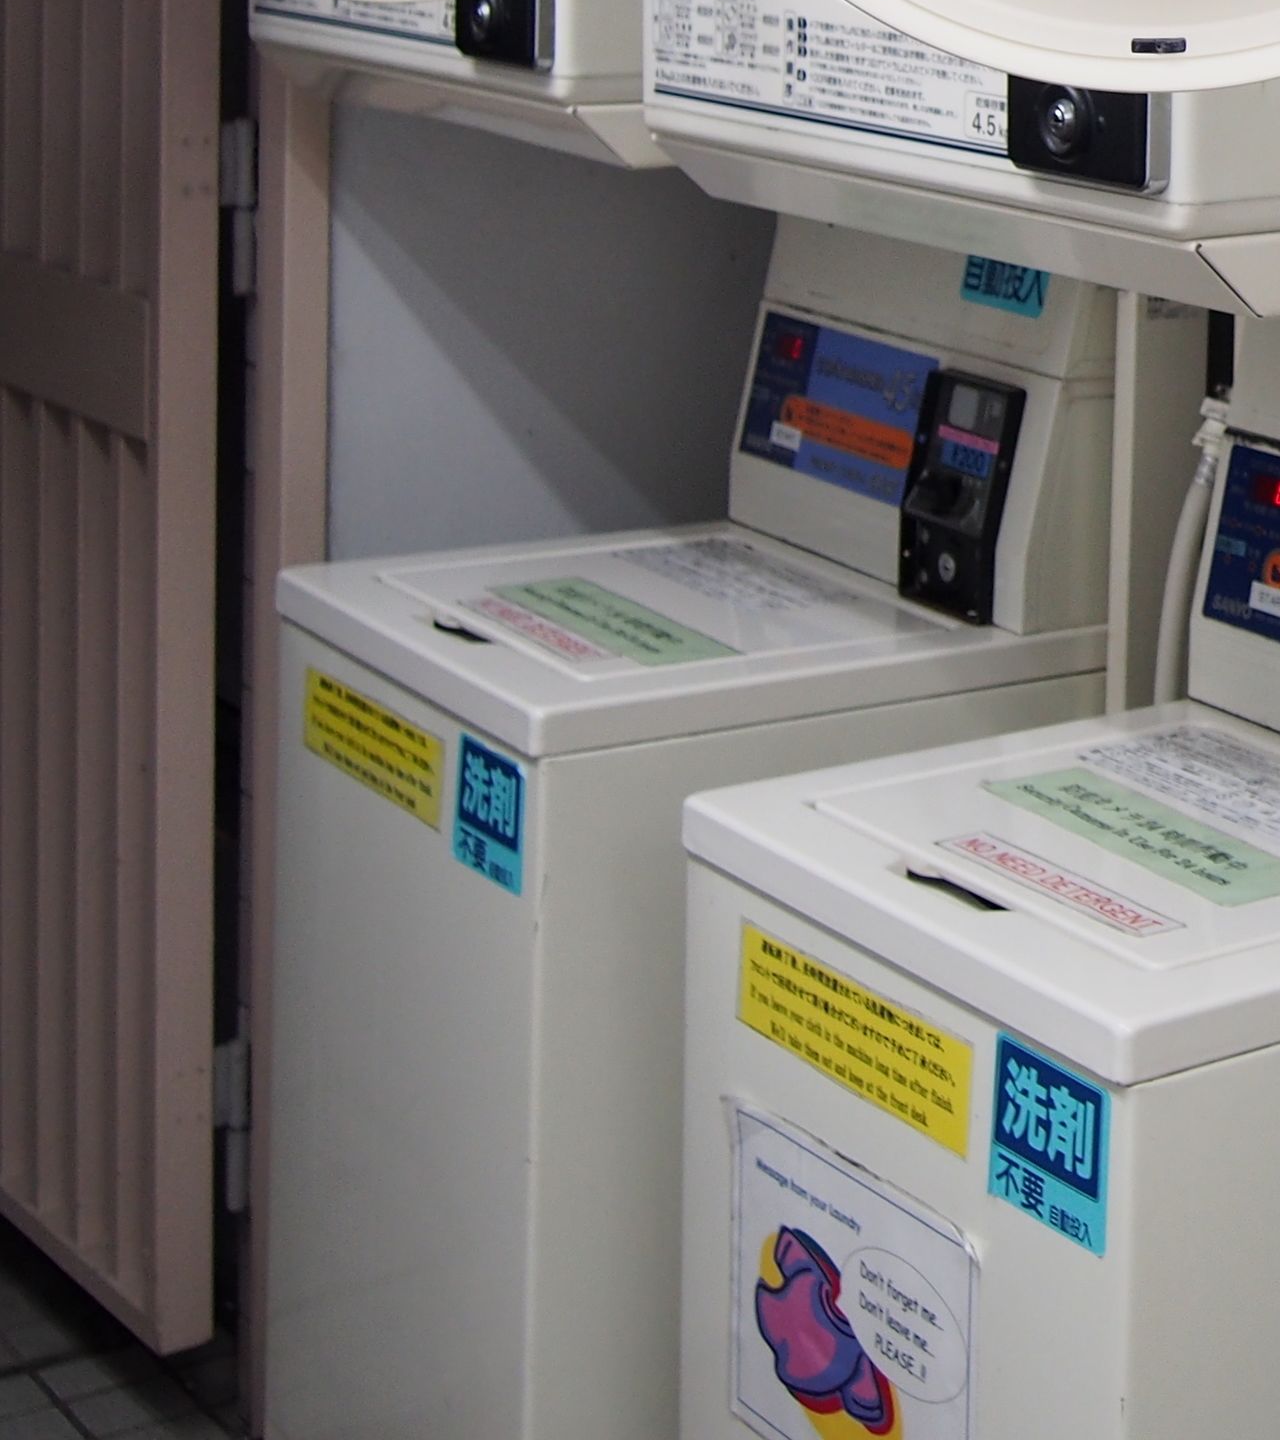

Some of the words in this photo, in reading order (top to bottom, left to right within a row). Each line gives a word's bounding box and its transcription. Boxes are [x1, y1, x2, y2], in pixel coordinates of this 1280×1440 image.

[997, 852, 1046, 876] NEED
[1002, 1056, 1096, 1180] 洗剤
[995, 1151, 1046, 1219] 不要
[887, 1281, 919, 1313] forget
